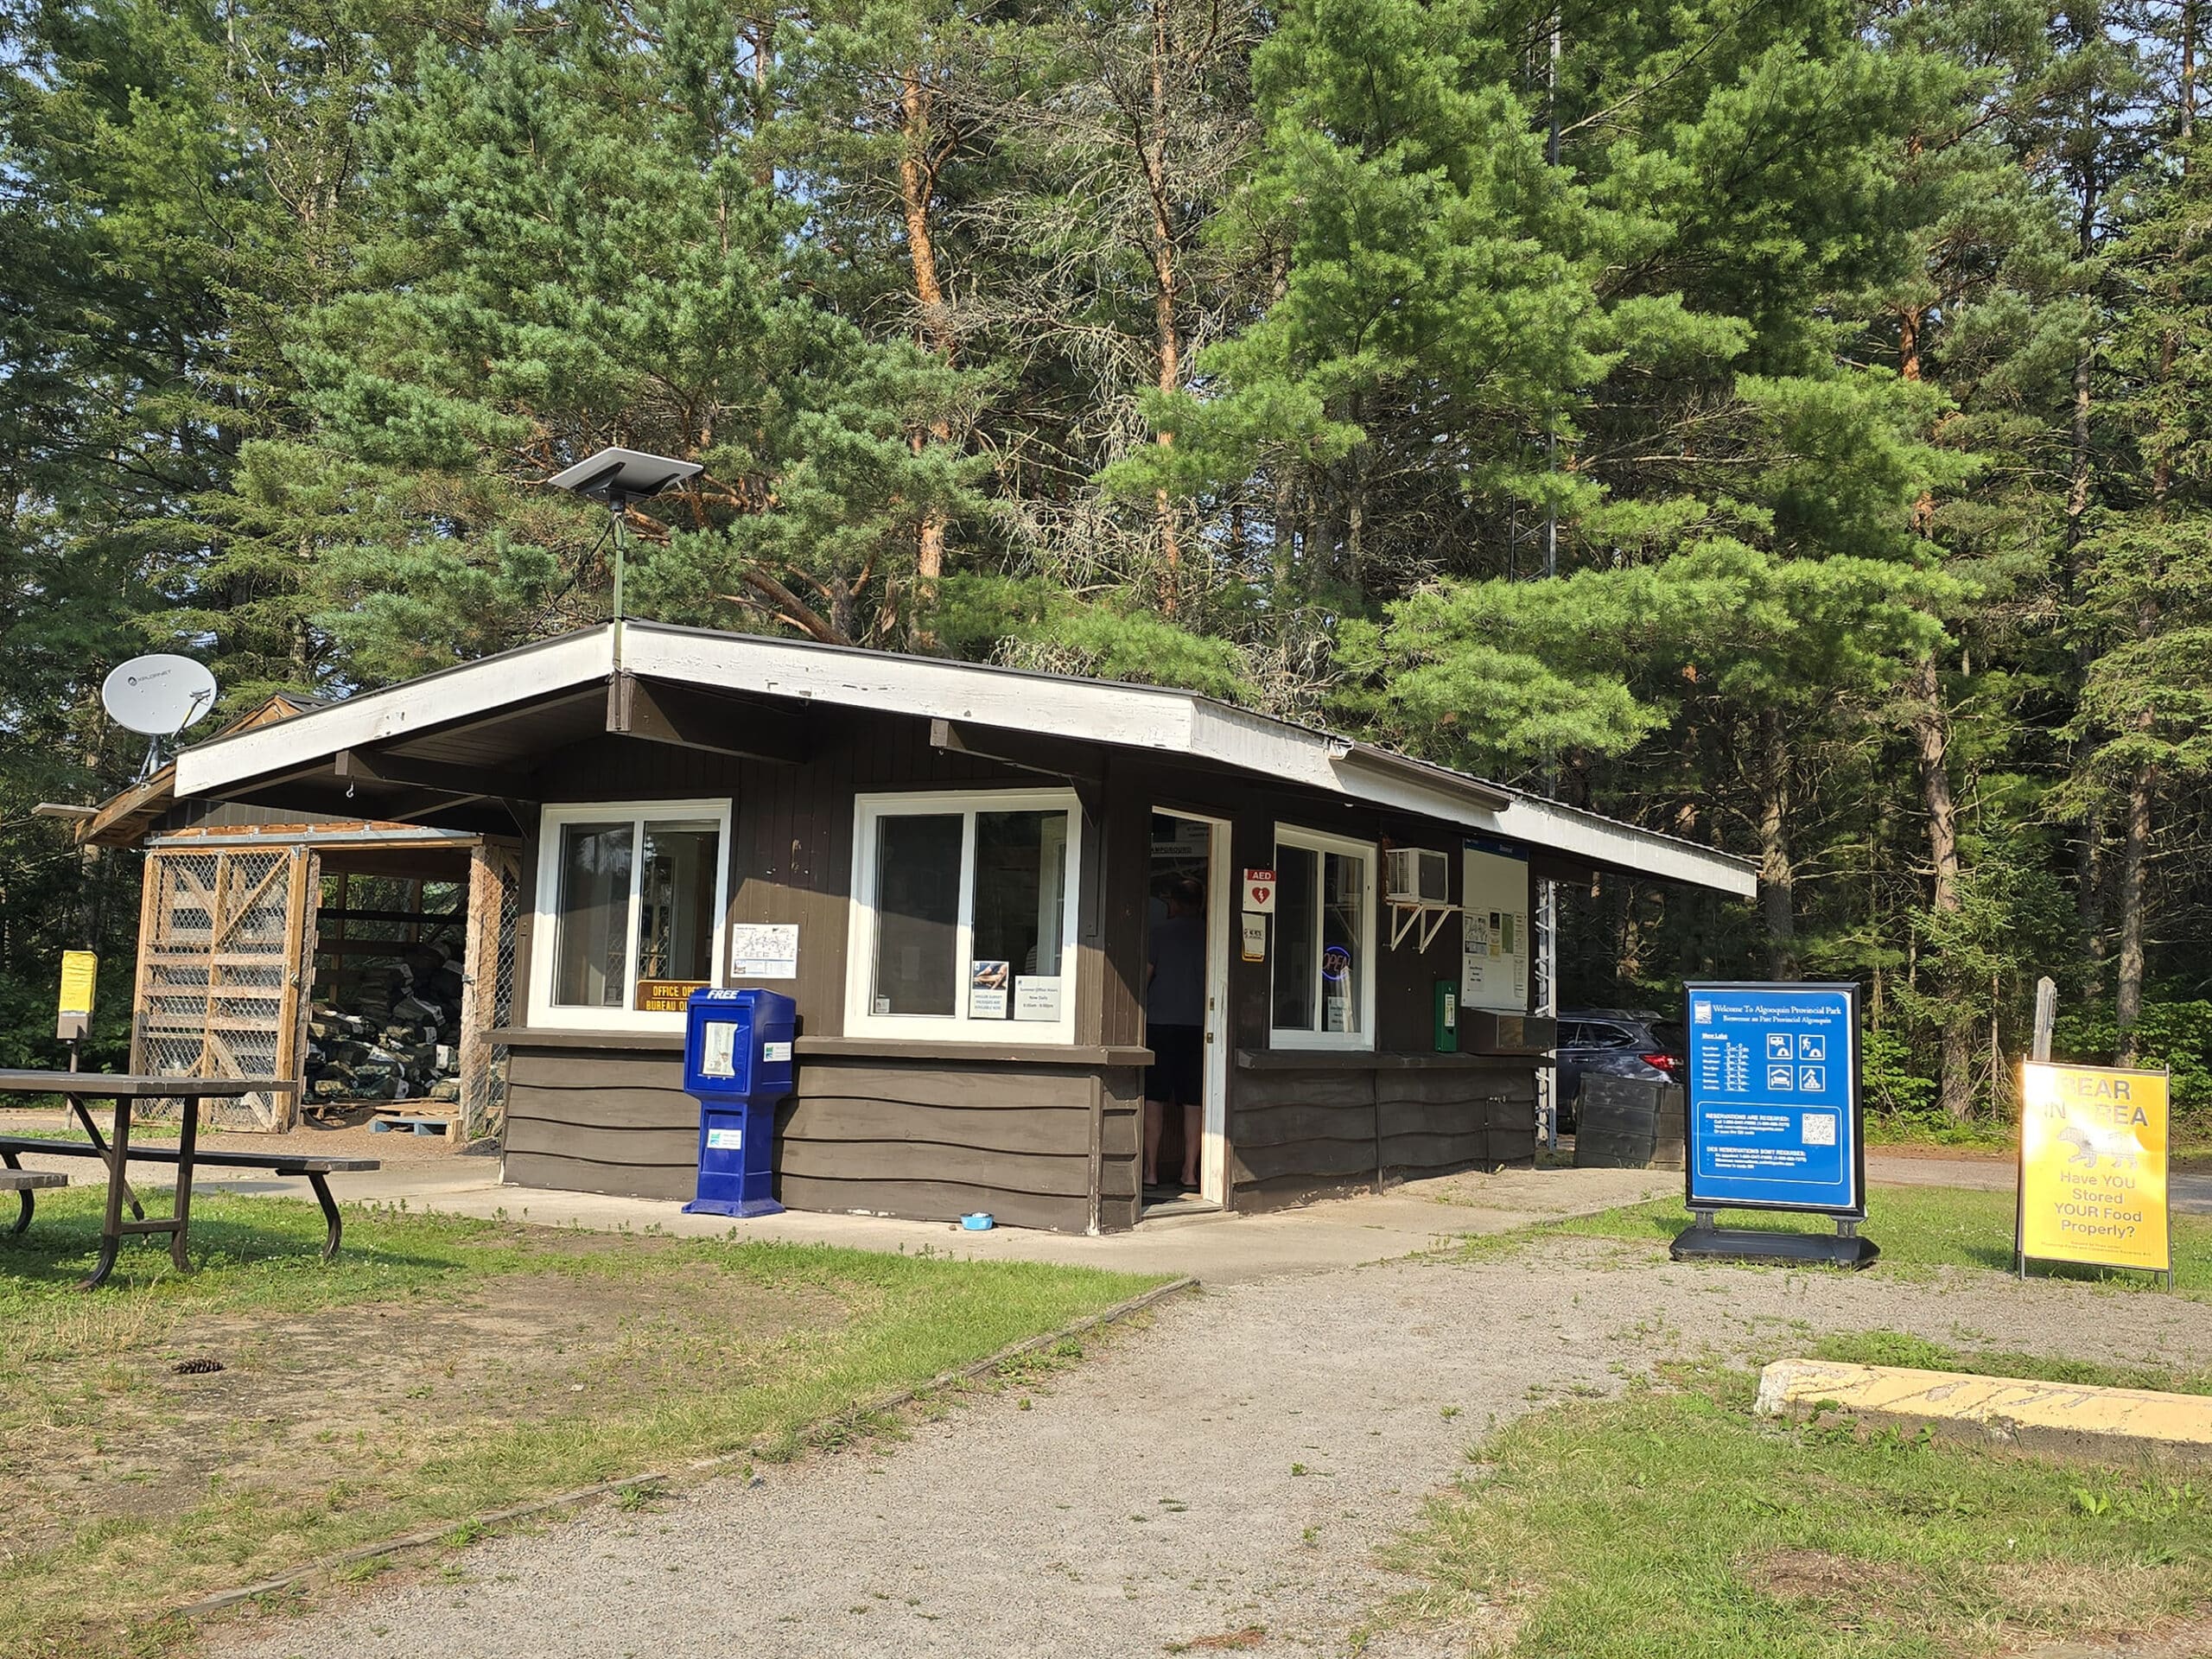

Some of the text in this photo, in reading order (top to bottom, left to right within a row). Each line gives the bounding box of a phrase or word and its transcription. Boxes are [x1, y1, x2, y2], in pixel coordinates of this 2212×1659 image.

[1252, 871, 1272, 880] AED
[652, 986, 702, 997] OFFICE OP
[706, 989, 740, 1000] FREE
[645, 1001, 677, 1011] BUREAU
[1713, 1004, 1743, 1013] Welcome
[1754, 1005, 1789, 1015] Algonquin
[1790, 1006, 1825, 1014] Provincial
[1802, 1016, 1832, 1026] Algonquin
[2044, 1102, 2066, 1119] IN
[2060, 1169, 2136, 1190] Have YOU
[2072, 1187, 2123, 1205] Stored
[2054, 1202, 2142, 1223] YOUR Food
[2061, 1218, 2135, 1240] Properly?
